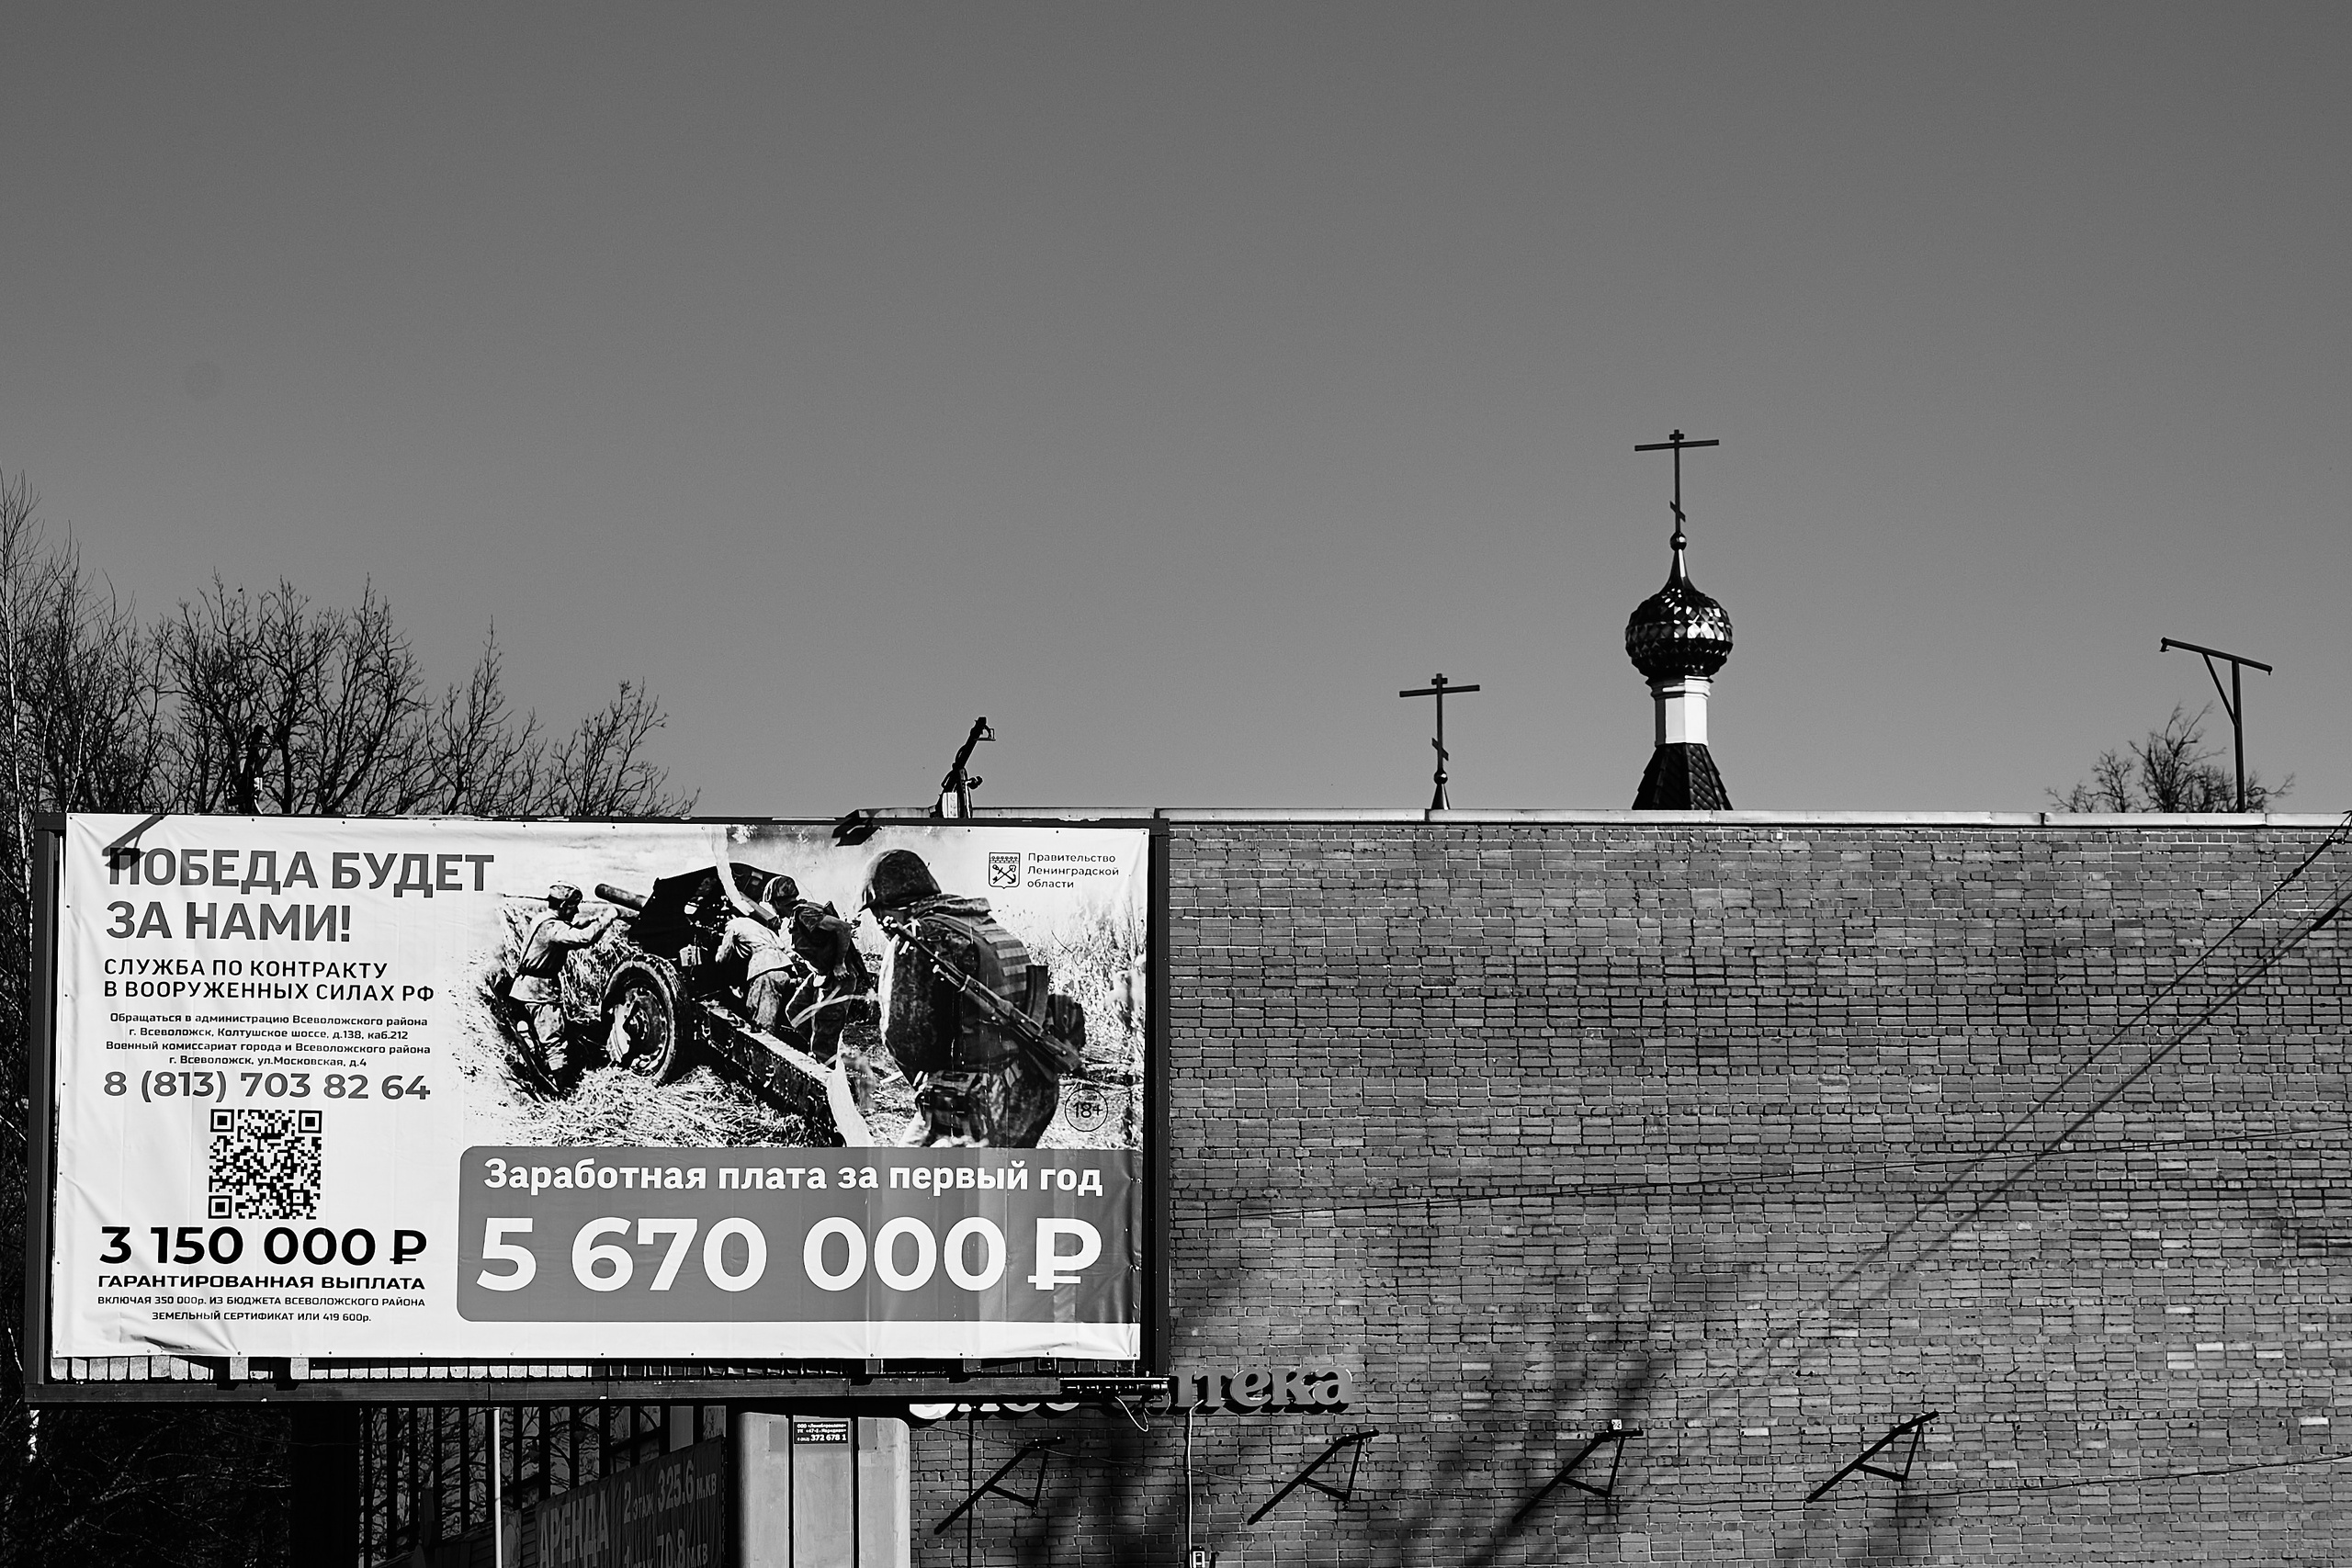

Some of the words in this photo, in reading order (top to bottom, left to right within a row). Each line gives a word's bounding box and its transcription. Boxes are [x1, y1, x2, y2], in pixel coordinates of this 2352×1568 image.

[1027, 852, 1116, 863] Правительство
[109, 847, 319, 895] ПОБЕДА
[332, 852, 494, 897] БУДЕТ
[1027, 865, 1119, 876] Ленинградской
[1027, 879, 1074, 888] области
[107, 901, 173, 939] ЗА
[186, 902, 351, 942] НАМИ!
[104, 958, 205, 976] СЛУЖБА
[213, 959, 243, 976] ПО
[251, 960, 388, 979] КОНТРАКТУ
[104, 981, 118, 998] В
[125, 981, 309, 999] ВООРУЖЕННЫХ
[316, 983, 395, 1002] СИЛАХ
[402, 985, 435, 1002] РФ
[110, 1012, 181, 1023] Обращаться
[185, 1014, 192, 1022] в
[195, 1015, 289, 1024] администрацию
[292, 1015, 383, 1025] Всеволожского
[386, 1017, 428, 1027] района
[129, 1028, 137, 1036] г.
[140, 1027, 214, 1037] Всеволожск,
[218, 1028, 288, 1038] Колтушское
[291, 1030, 329, 1039] шоссе,
[333, 1030, 364, 1040] д.138,
[368, 1031, 409, 1040] каб.212
[106, 1041, 159, 1050] Военный
[162, 1043, 237, 1052] комиссариат
[241, 1043, 281, 1053] города
[295, 1043, 386, 1053] Всеволожского
[389, 1045, 431, 1055] района
[180, 1055, 254, 1065] Всеволожск,
[257, 1056, 346, 1066] ул.Московская,
[349, 1058, 367, 1067] д.4
[104, 1071, 127, 1097] 8
[141, 1070, 226, 1103] (813)
[241, 1072, 311, 1099] 703
[323, 1074, 368, 1100] 82
[381, 1075, 431, 1100] 64
[1073, 1102, 1103, 1118] 18+
[483, 1157, 707, 1195] Заработная
[718, 1167, 826, 1190] плата
[838, 1167, 879, 1190] за
[888, 1159, 1029, 1197] первый
[1040, 1167, 1103, 1197] год
[98, 1226, 132, 1264] 3
[151, 1226, 243, 1265] 150
[264, 1226, 376, 1266] 000
[475, 1217, 537, 1292] 5
[571, 1216, 767, 1292] 670
[803, 1216, 1008, 1292] 000
[98, 1275, 314, 1288] ГАРАНТИРОВАННАЯ
[322, 1277, 425, 1290] ВЫПЛАТА
[97, 1296, 152, 1304] ВКЛЮЧАЯ
[154, 1296, 174, 1304] 350
[176, 1296, 207, 1305] 000р.
[209, 1296, 223, 1304] ИЗ
[226, 1297, 281, 1305] БЮДЖЕТА
[285, 1297, 379, 1306] ВСЕВОЛОЖСКОГО
[382, 1296, 425, 1306] РАЙОНА
[152, 1311, 220, 1320] ЗЕМЕЛЬНЫЙ
[223, 1312, 294, 1321] СЕРТИФИКАТ
[298, 1313, 320, 1321] ИЛИ
[322, 1313, 339, 1321] 419
[343, 1314, 371, 1323] 600р.
[810, 1433, 825, 1441] 372
[826, 1433, 841, 1441] 678
[842, 1433, 847, 1441] 1
[624, 1481, 631, 1525] 2
[657, 1459, 695, 1513] 325.6
[539, 1489, 610, 1567] АРЕНДА
